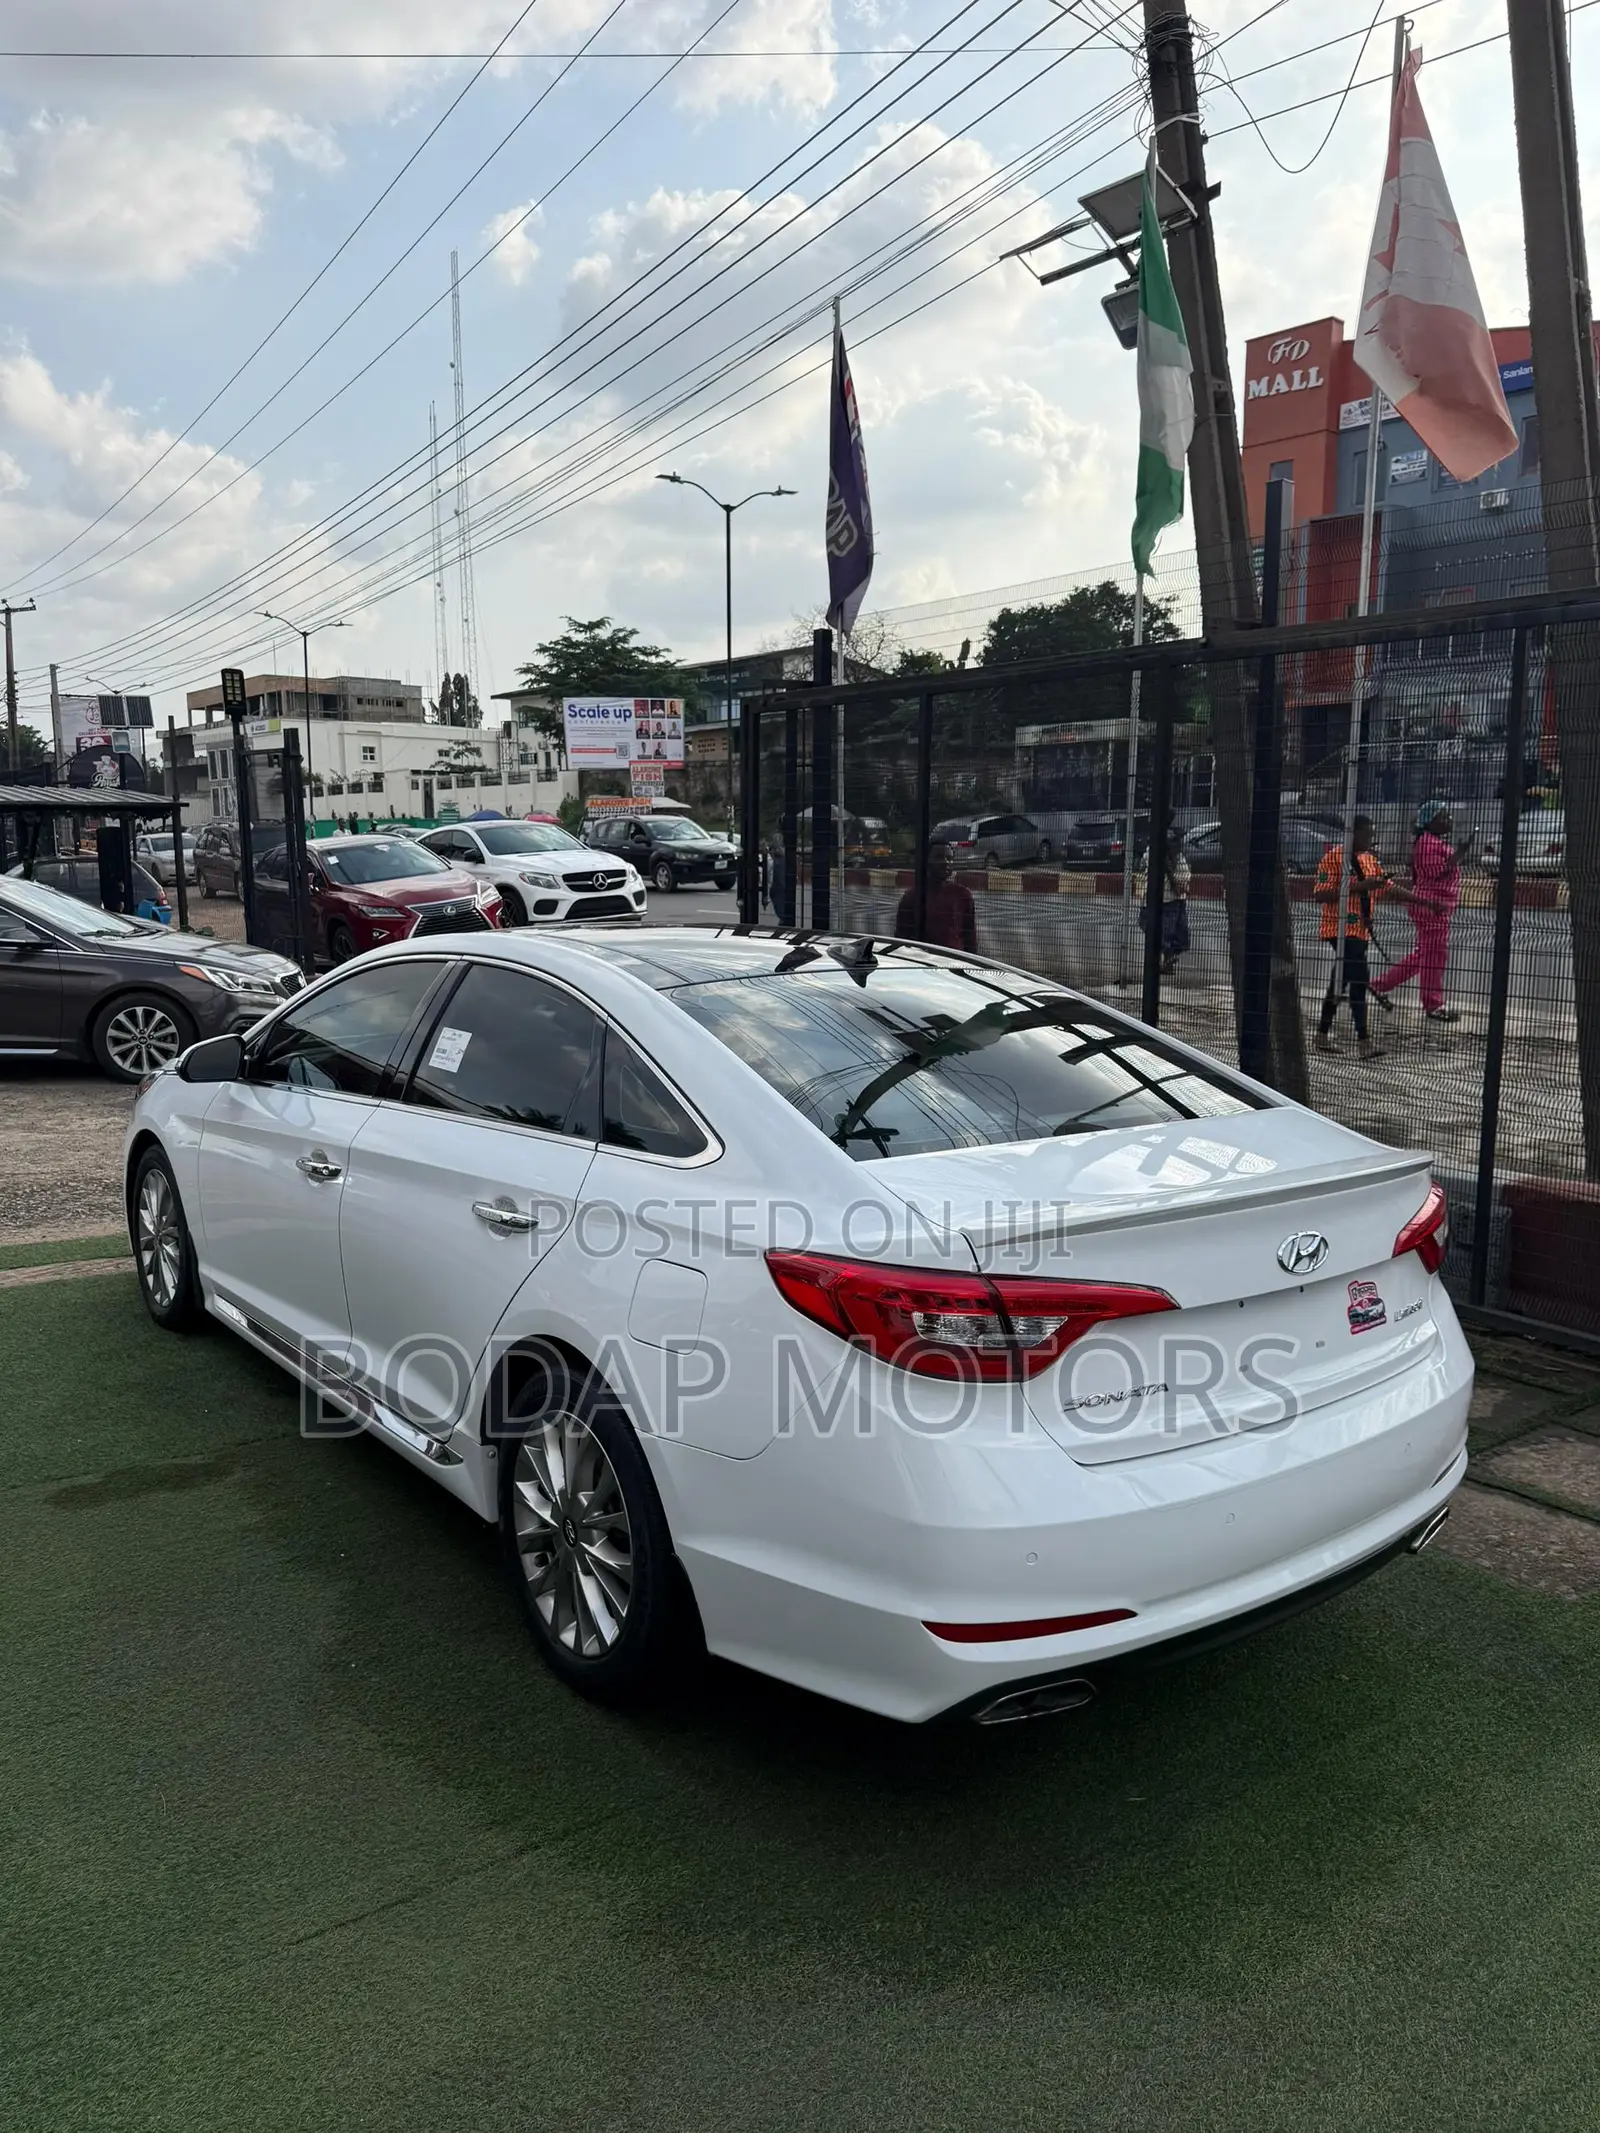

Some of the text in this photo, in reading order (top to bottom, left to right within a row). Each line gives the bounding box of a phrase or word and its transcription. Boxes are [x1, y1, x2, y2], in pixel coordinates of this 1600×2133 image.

[1247, 366, 1324, 400] MALL
[568, 704, 633, 722] Scale up
[1063, 1382, 1169, 1412] SONATA
